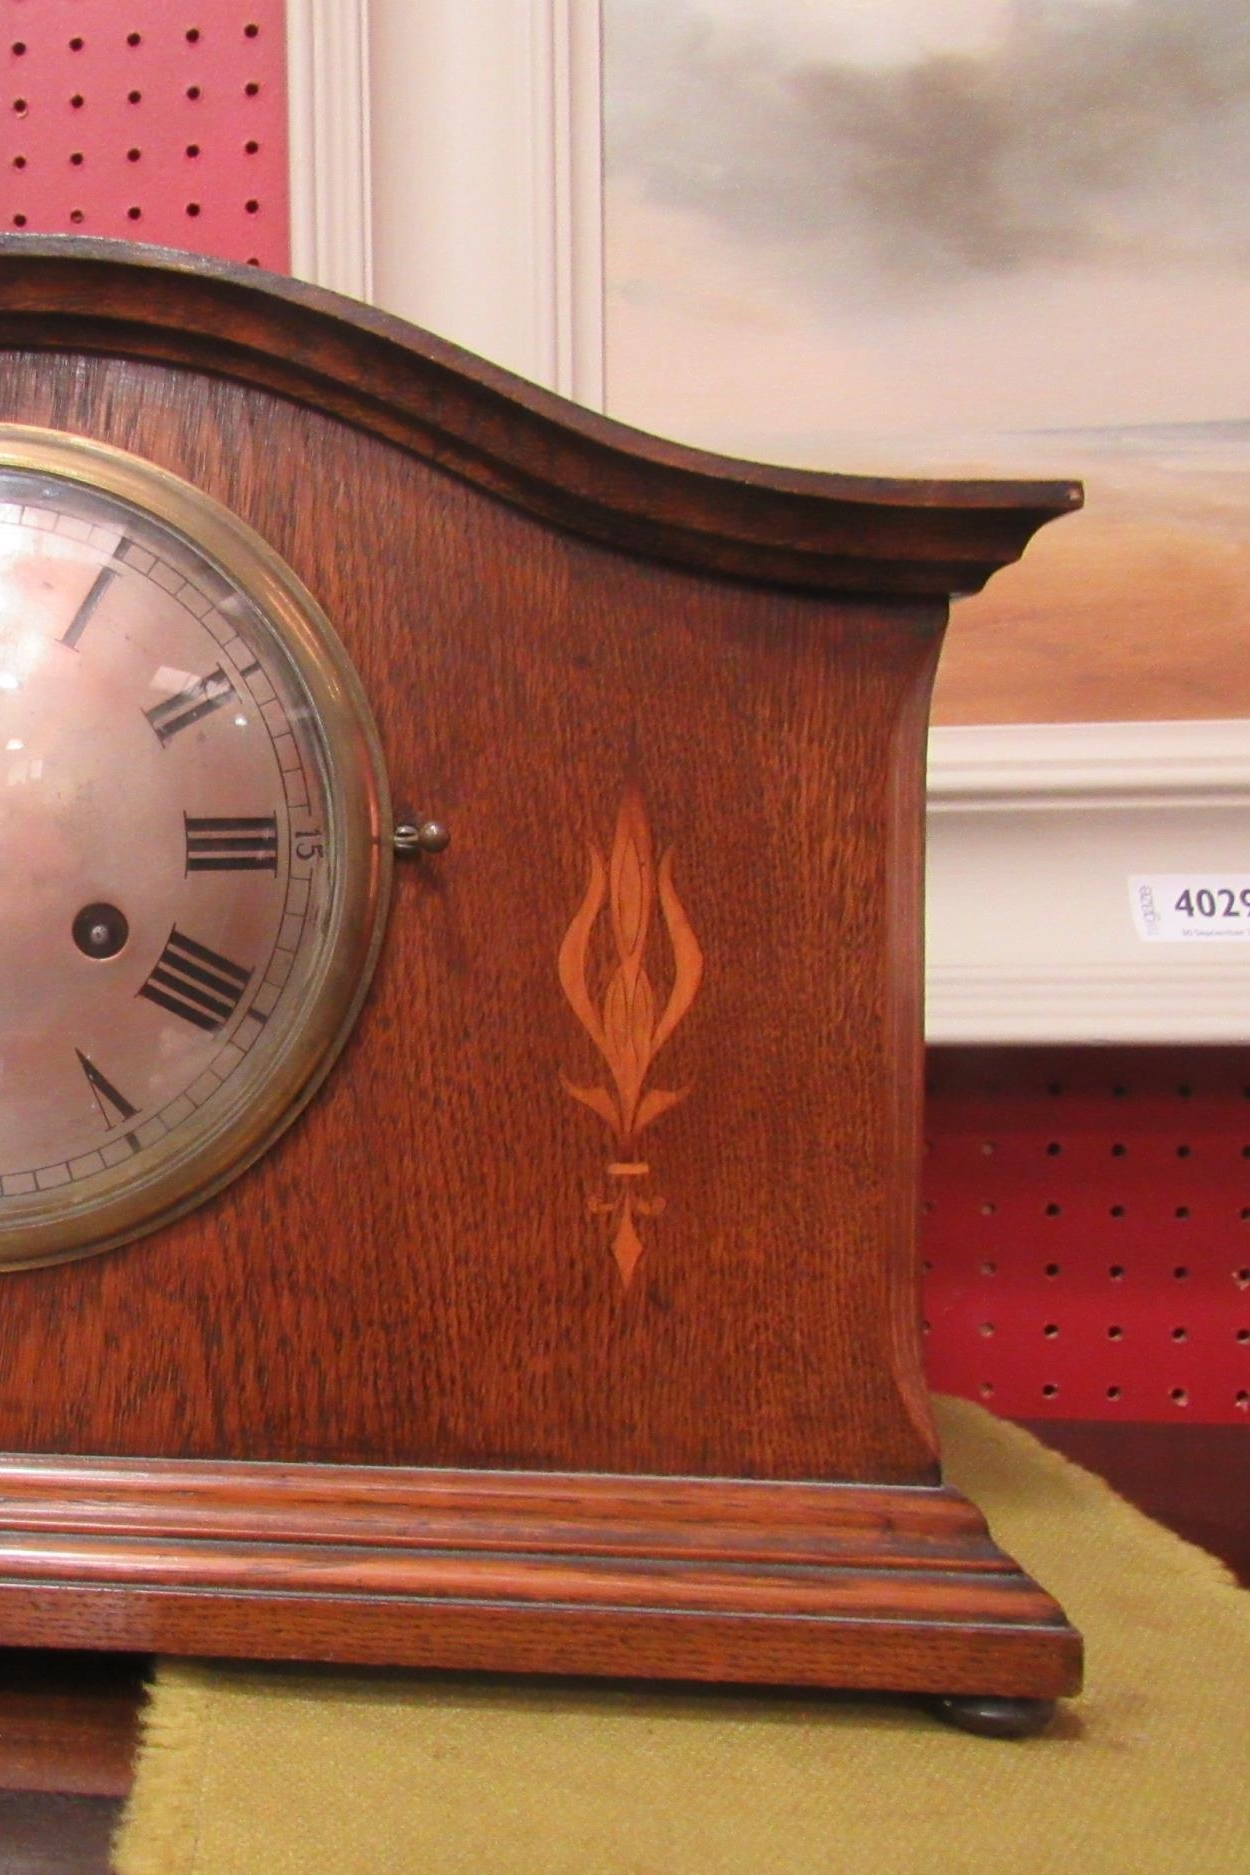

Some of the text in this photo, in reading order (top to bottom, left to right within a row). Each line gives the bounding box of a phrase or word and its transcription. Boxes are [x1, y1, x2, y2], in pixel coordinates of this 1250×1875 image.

[55, 565, 123, 653] I
[140, 661, 243, 749] II
[183, 810, 278, 880] III
[294, 828, 324, 861] 15
[134, 922, 255, 1040] IIII
[74, 1047, 143, 1132] V
